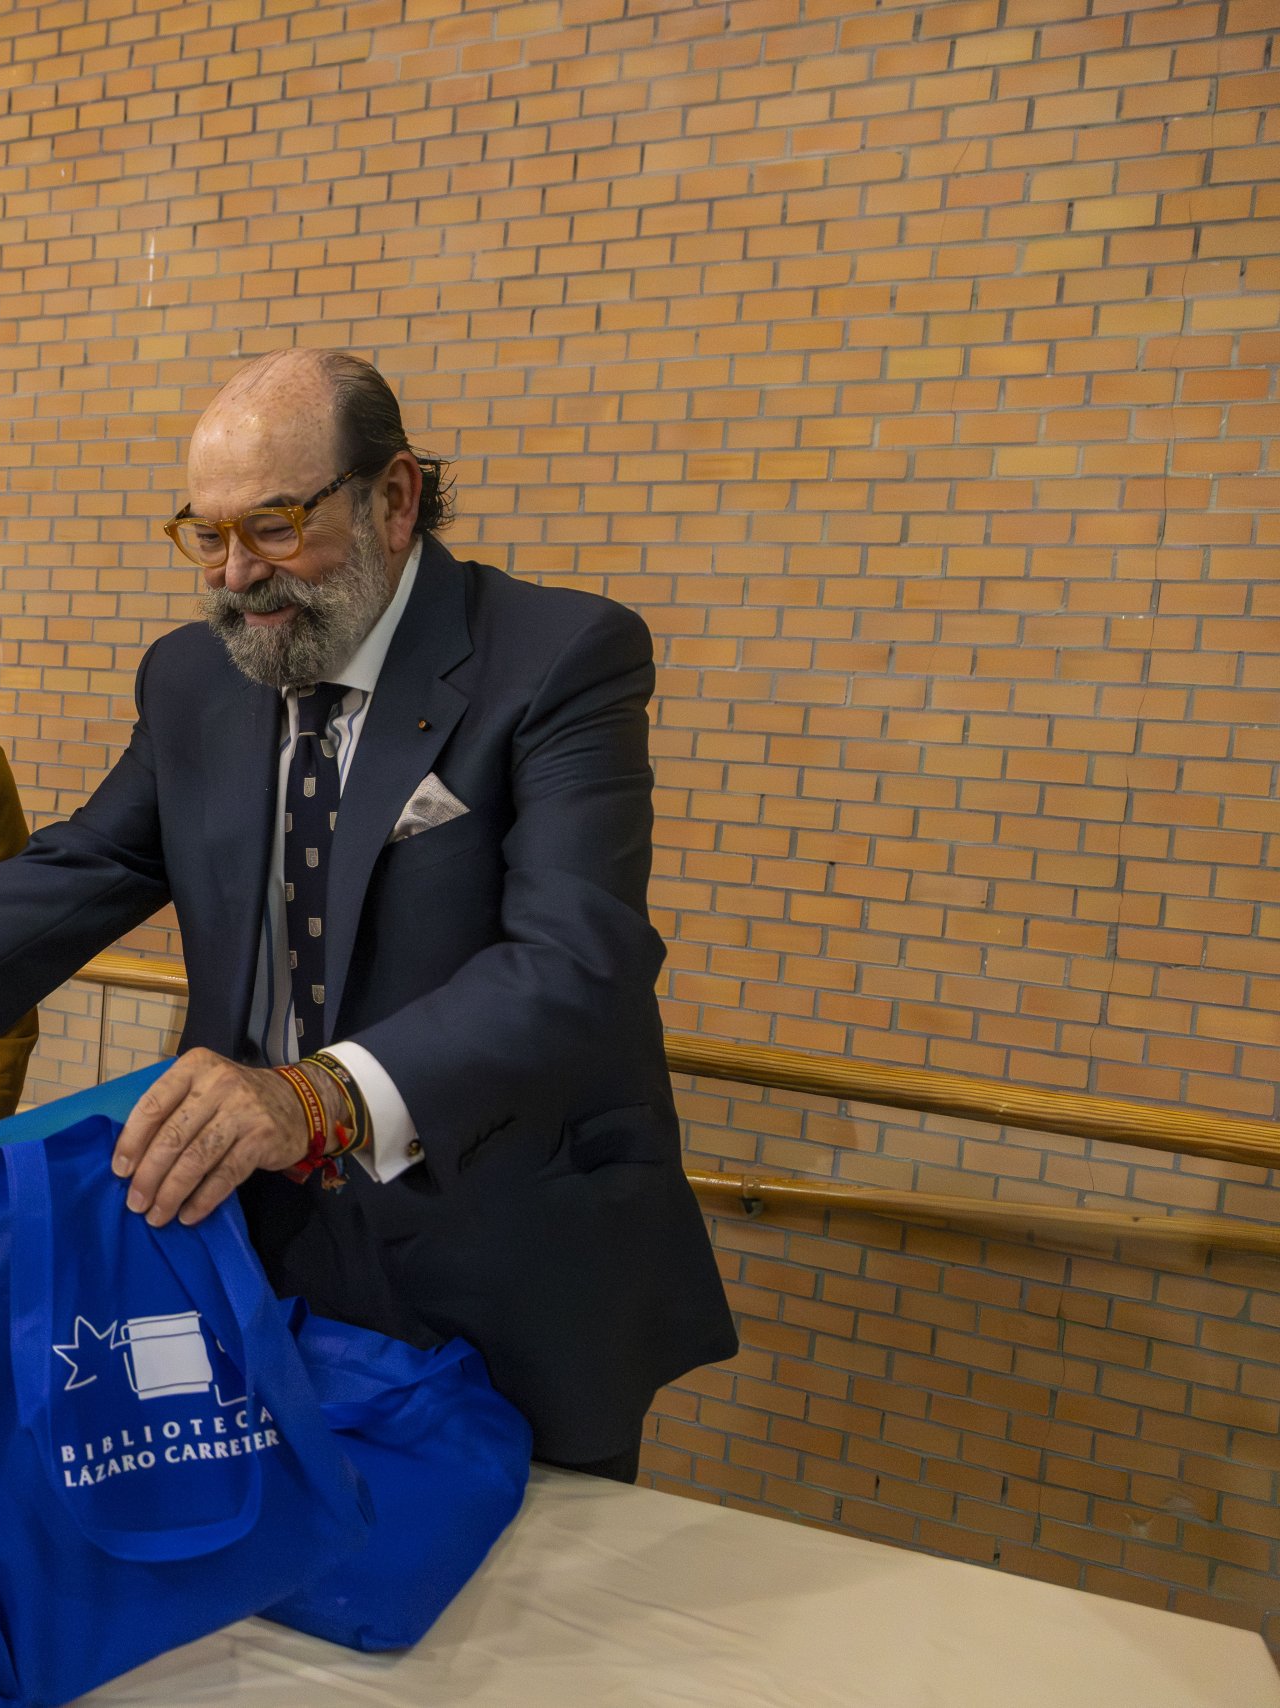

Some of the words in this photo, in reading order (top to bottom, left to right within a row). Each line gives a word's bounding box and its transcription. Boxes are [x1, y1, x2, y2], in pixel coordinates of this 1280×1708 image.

[61, 1406, 273, 1463] BIBLIOTECA
[64, 1451, 156, 1487] LÁZARO
[164, 1429, 280, 1463] CARRETER
